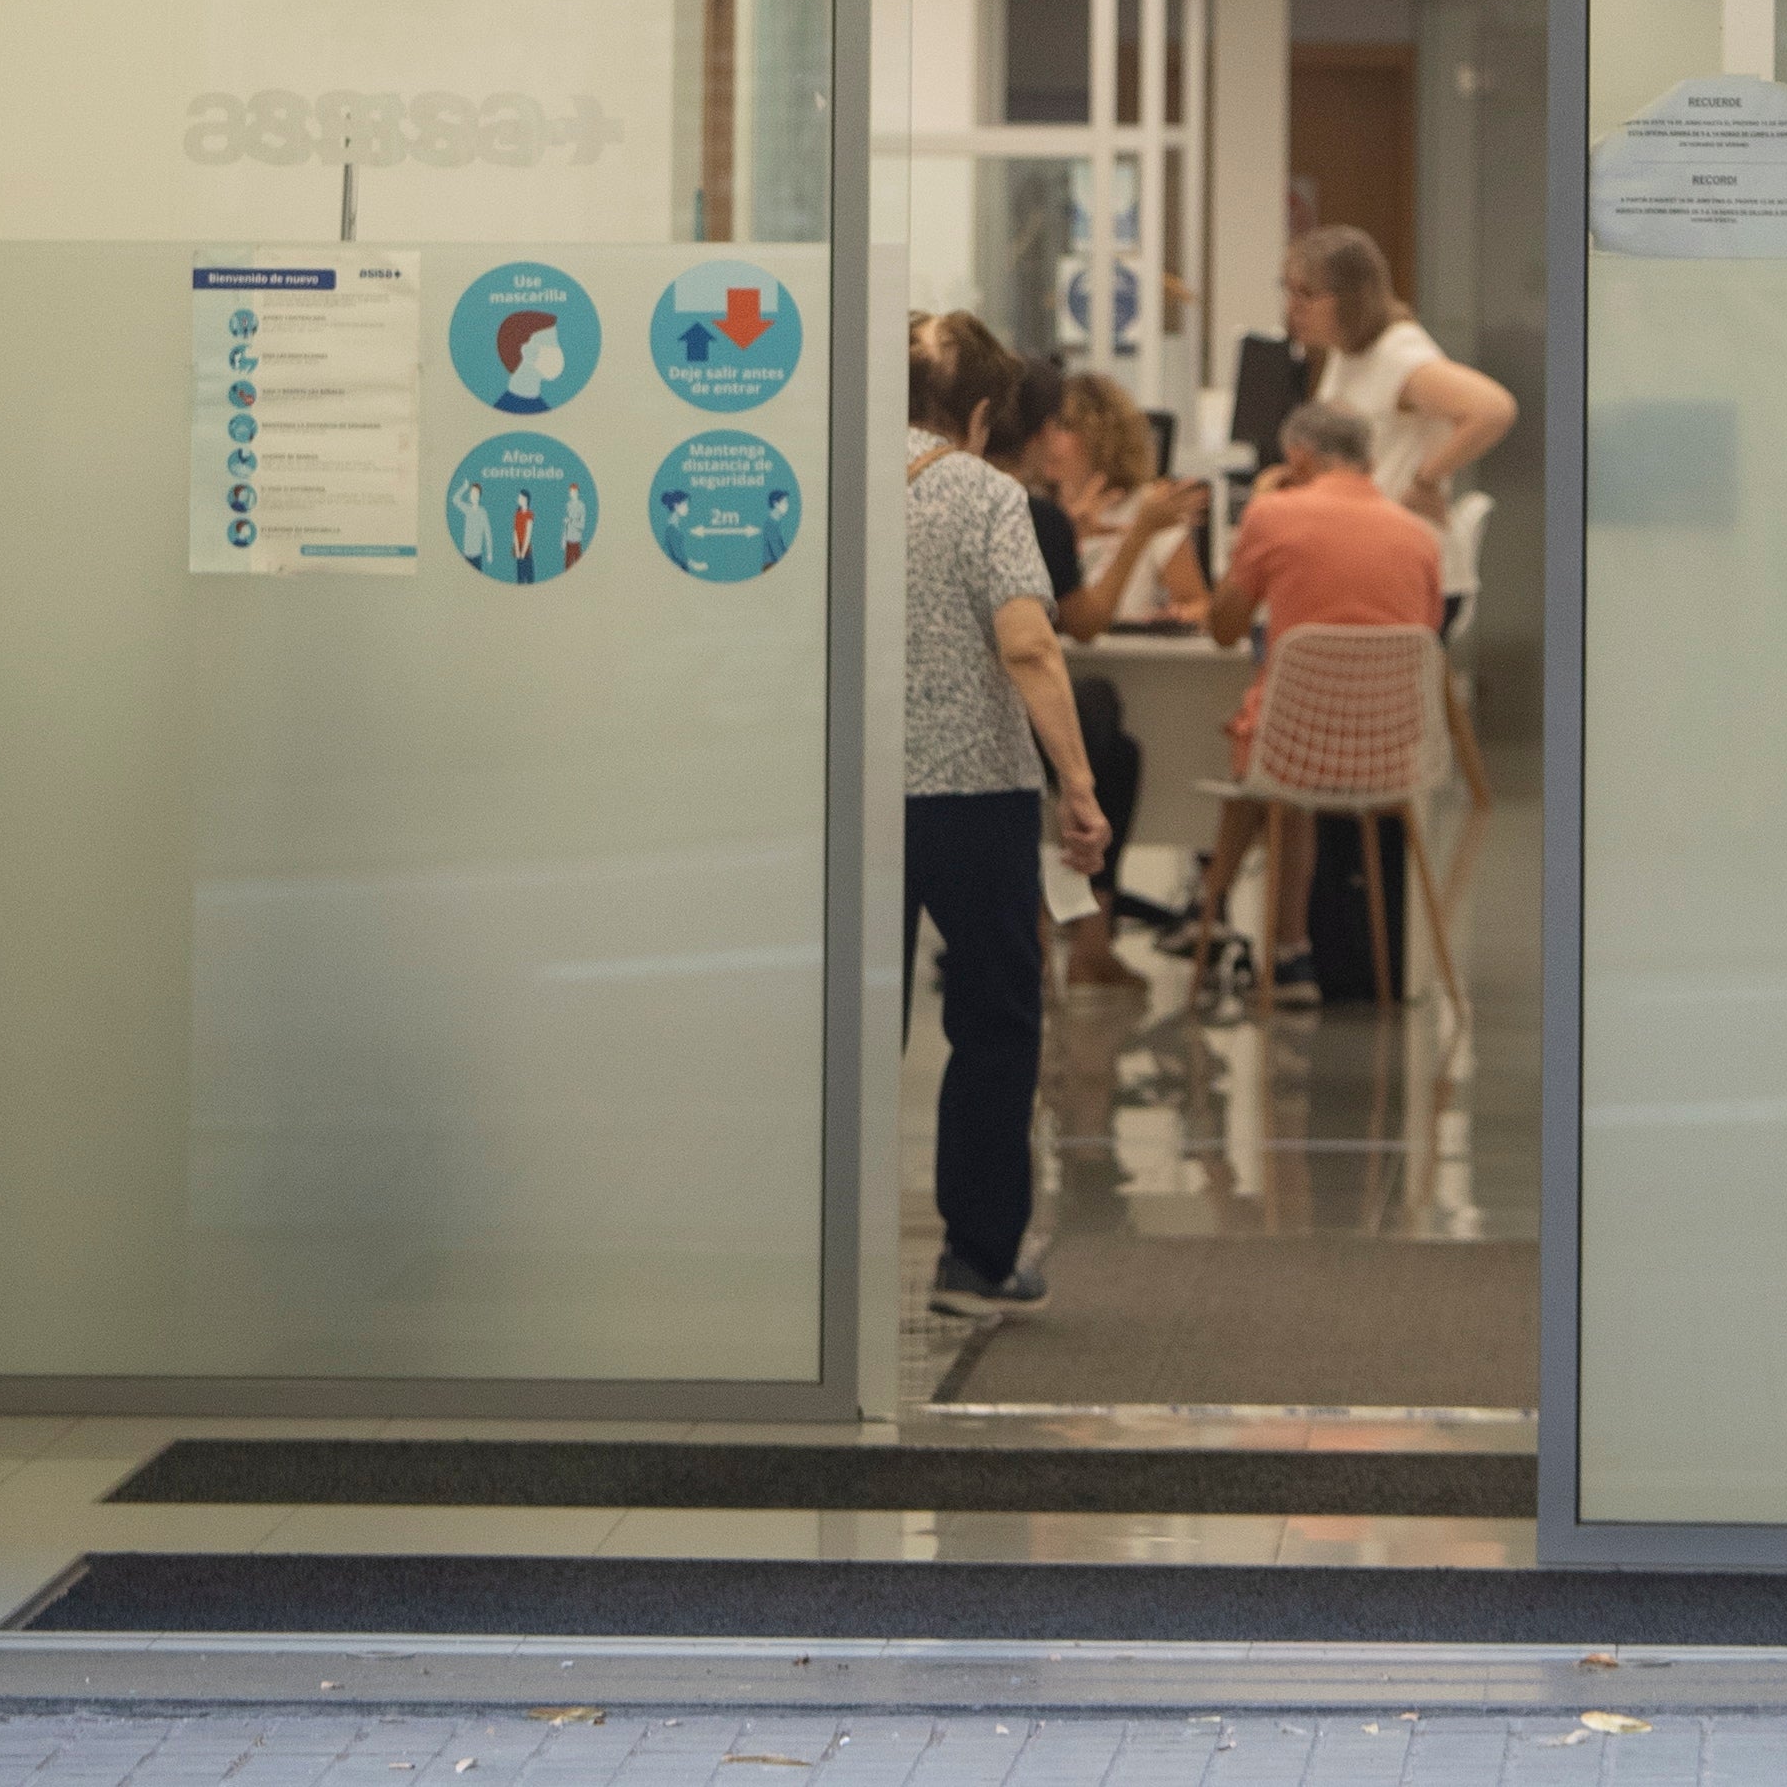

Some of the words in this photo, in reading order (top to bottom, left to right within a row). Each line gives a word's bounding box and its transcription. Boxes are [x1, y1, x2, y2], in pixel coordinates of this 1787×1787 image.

[1687, 97, 1743, 108] RECUERDE
[1692, 175, 1737, 186] RECORDI
[208, 273, 268, 284] Bienvenido
[270, 273, 283, 284] de
[285, 275, 319, 285] nuevo
[514, 275, 542, 288] Use
[489, 289, 567, 304] mascarilla
[668, 366, 702, 382] Deje
[706, 366, 737, 380] salir
[742, 368, 785, 380] antes
[691, 382, 710, 395] de
[714, 384, 762, 395] entrar
[502, 450, 544, 463] Aforo
[689, 444, 766, 459] Mantenga
[481, 465, 564, 479] controlado
[682, 459, 751, 472] distancia
[754, 459, 774, 472] de
[689, 474, 765, 489] seguridad
[711, 508, 740, 525] 2m
